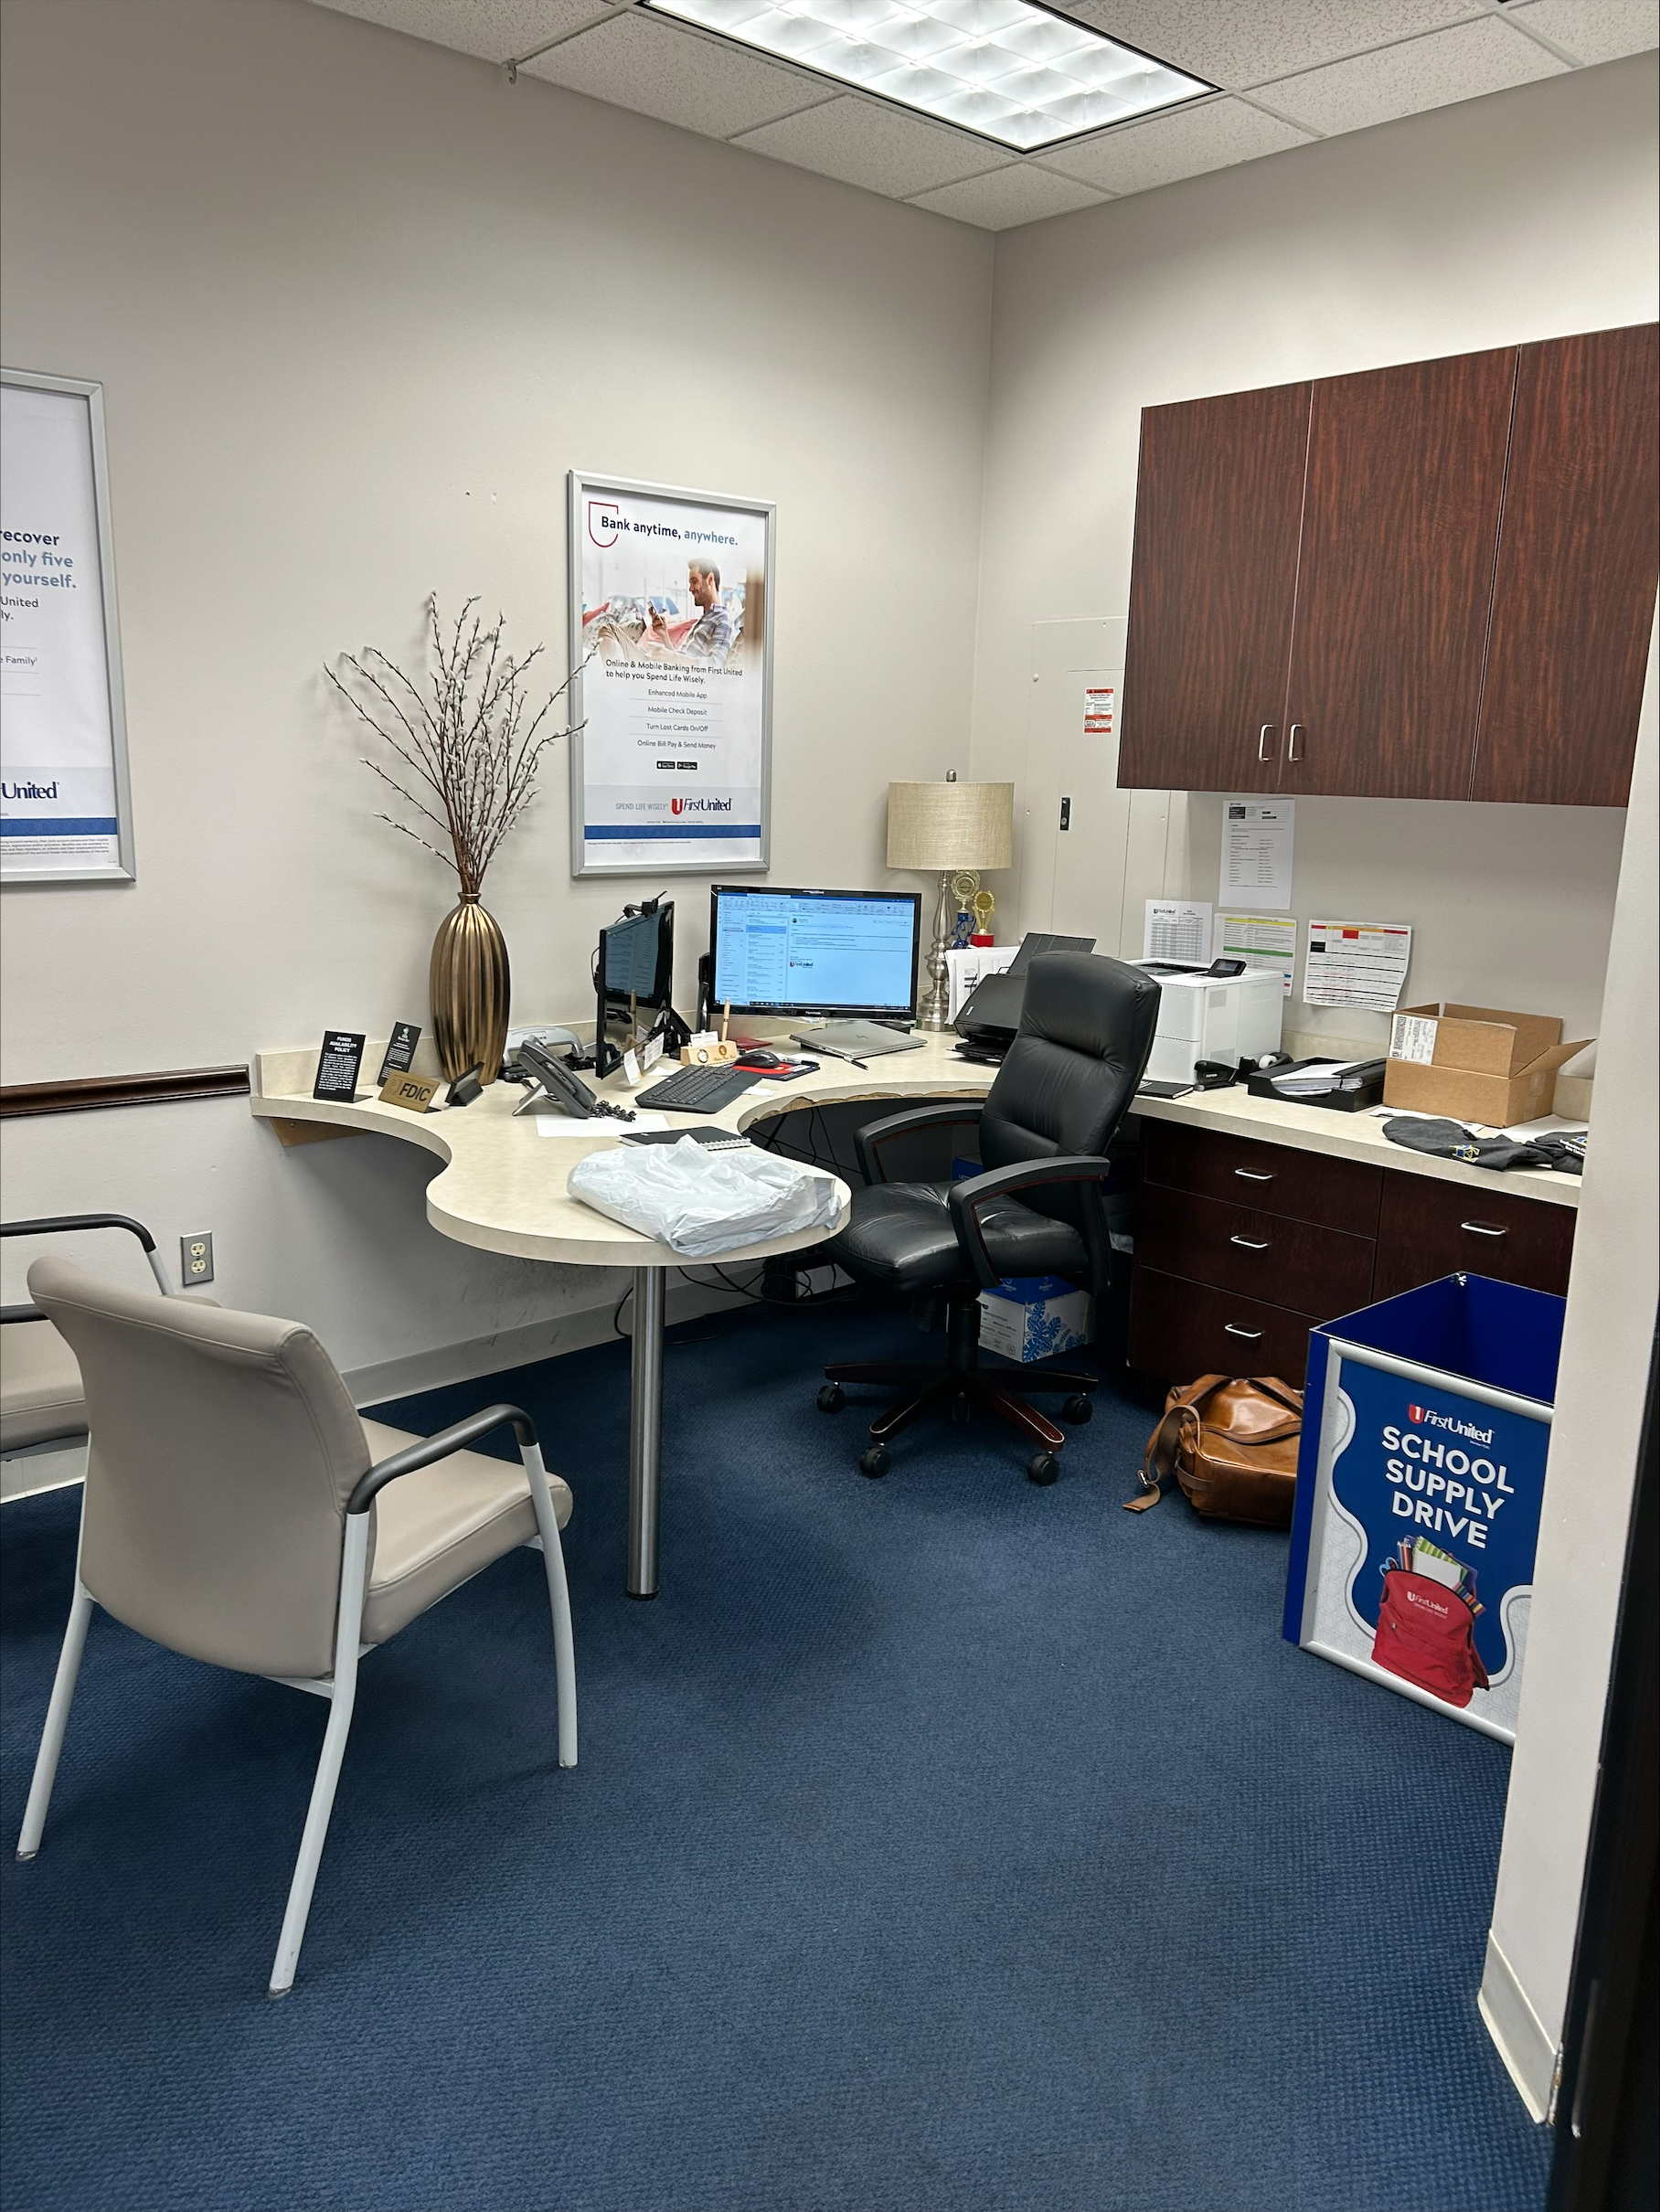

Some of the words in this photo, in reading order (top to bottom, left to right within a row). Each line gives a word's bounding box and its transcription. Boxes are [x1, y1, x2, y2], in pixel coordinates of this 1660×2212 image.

[0, 530, 59, 546] ecover
[601, 516, 631, 531] Bank
[633, 522, 681, 540] anytime,
[684, 530, 738, 546] anywhere.
[2, 549, 37, 568] only
[41, 551, 73, 568] five
[2, 572, 76, 589] yourself.
[606, 659, 628, 668] Online
[638, 661, 662, 671] Mobile
[664, 663, 689, 674] Banking
[691, 665, 707, 674] from
[708, 666, 722, 675] First
[723, 667, 743, 676] United
[615, 671, 630, 679] help
[633, 673, 644, 681] you
[646, 673, 667, 682] Spend
[683, 675, 706, 685] Wisely.
[648, 689, 676, 697] Enhanced
[676, 690, 695, 698] Mobile
[673, 724, 688, 732] Cards
[637, 739, 656, 748] Online
[667, 741, 676, 750] Pay
[697, 742, 716, 750] Money
[0, 782, 59, 800] United
[399, 1082, 431, 1101] FDIC
[1423, 1409, 1493, 1445] FirstUnited
[1381, 1425, 1515, 1495] SCHOOL
[1385, 1458, 1506, 1520] SUPPLY
[1392, 1490, 1489, 1549] DRIVE
